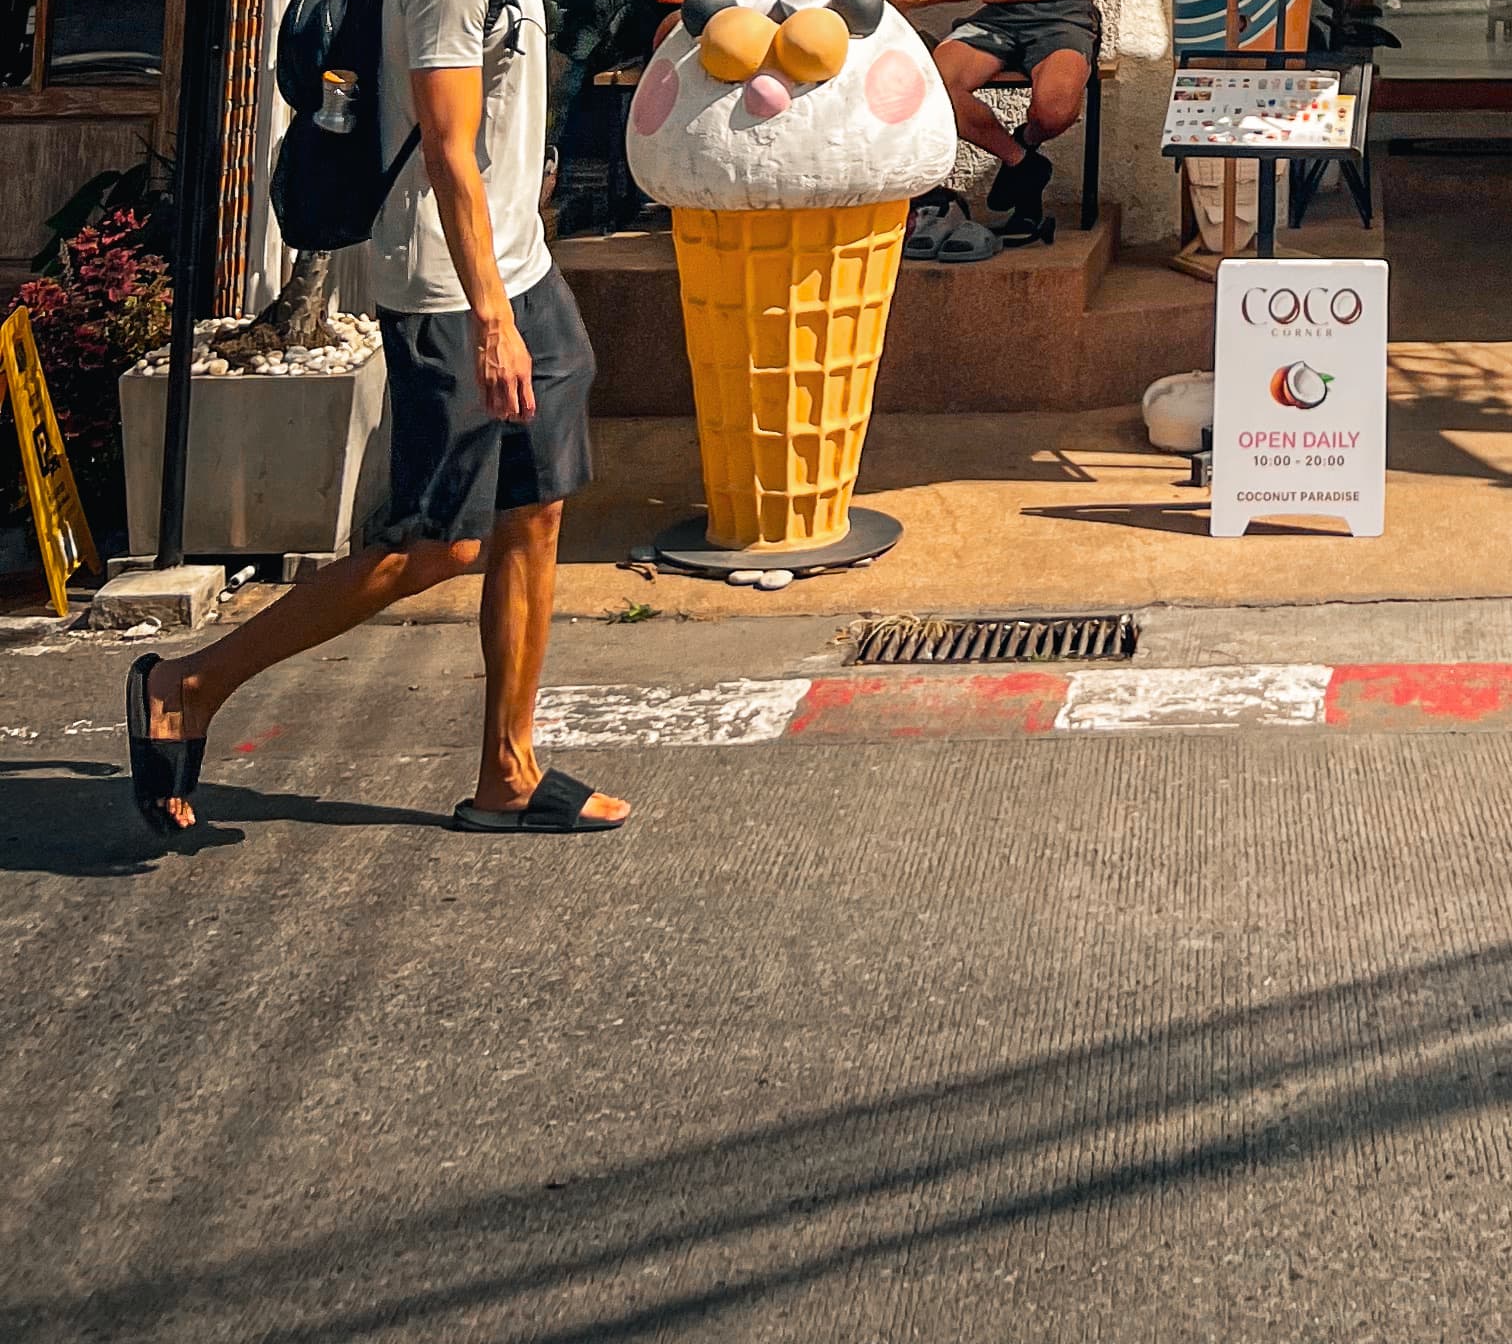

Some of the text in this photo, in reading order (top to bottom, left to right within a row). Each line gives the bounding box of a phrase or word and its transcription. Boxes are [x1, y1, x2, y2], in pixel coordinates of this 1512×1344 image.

[1241, 287, 1363, 325] COCO
[1271, 328, 1333, 337] CORNER
[1238, 431, 1360, 449] OPEN DAILY
[1253, 455, 1291, 466] 10:00
[1305, 455, 1345, 466] 20:00
[1236, 490, 1360, 502] COCONUT PARADISE
